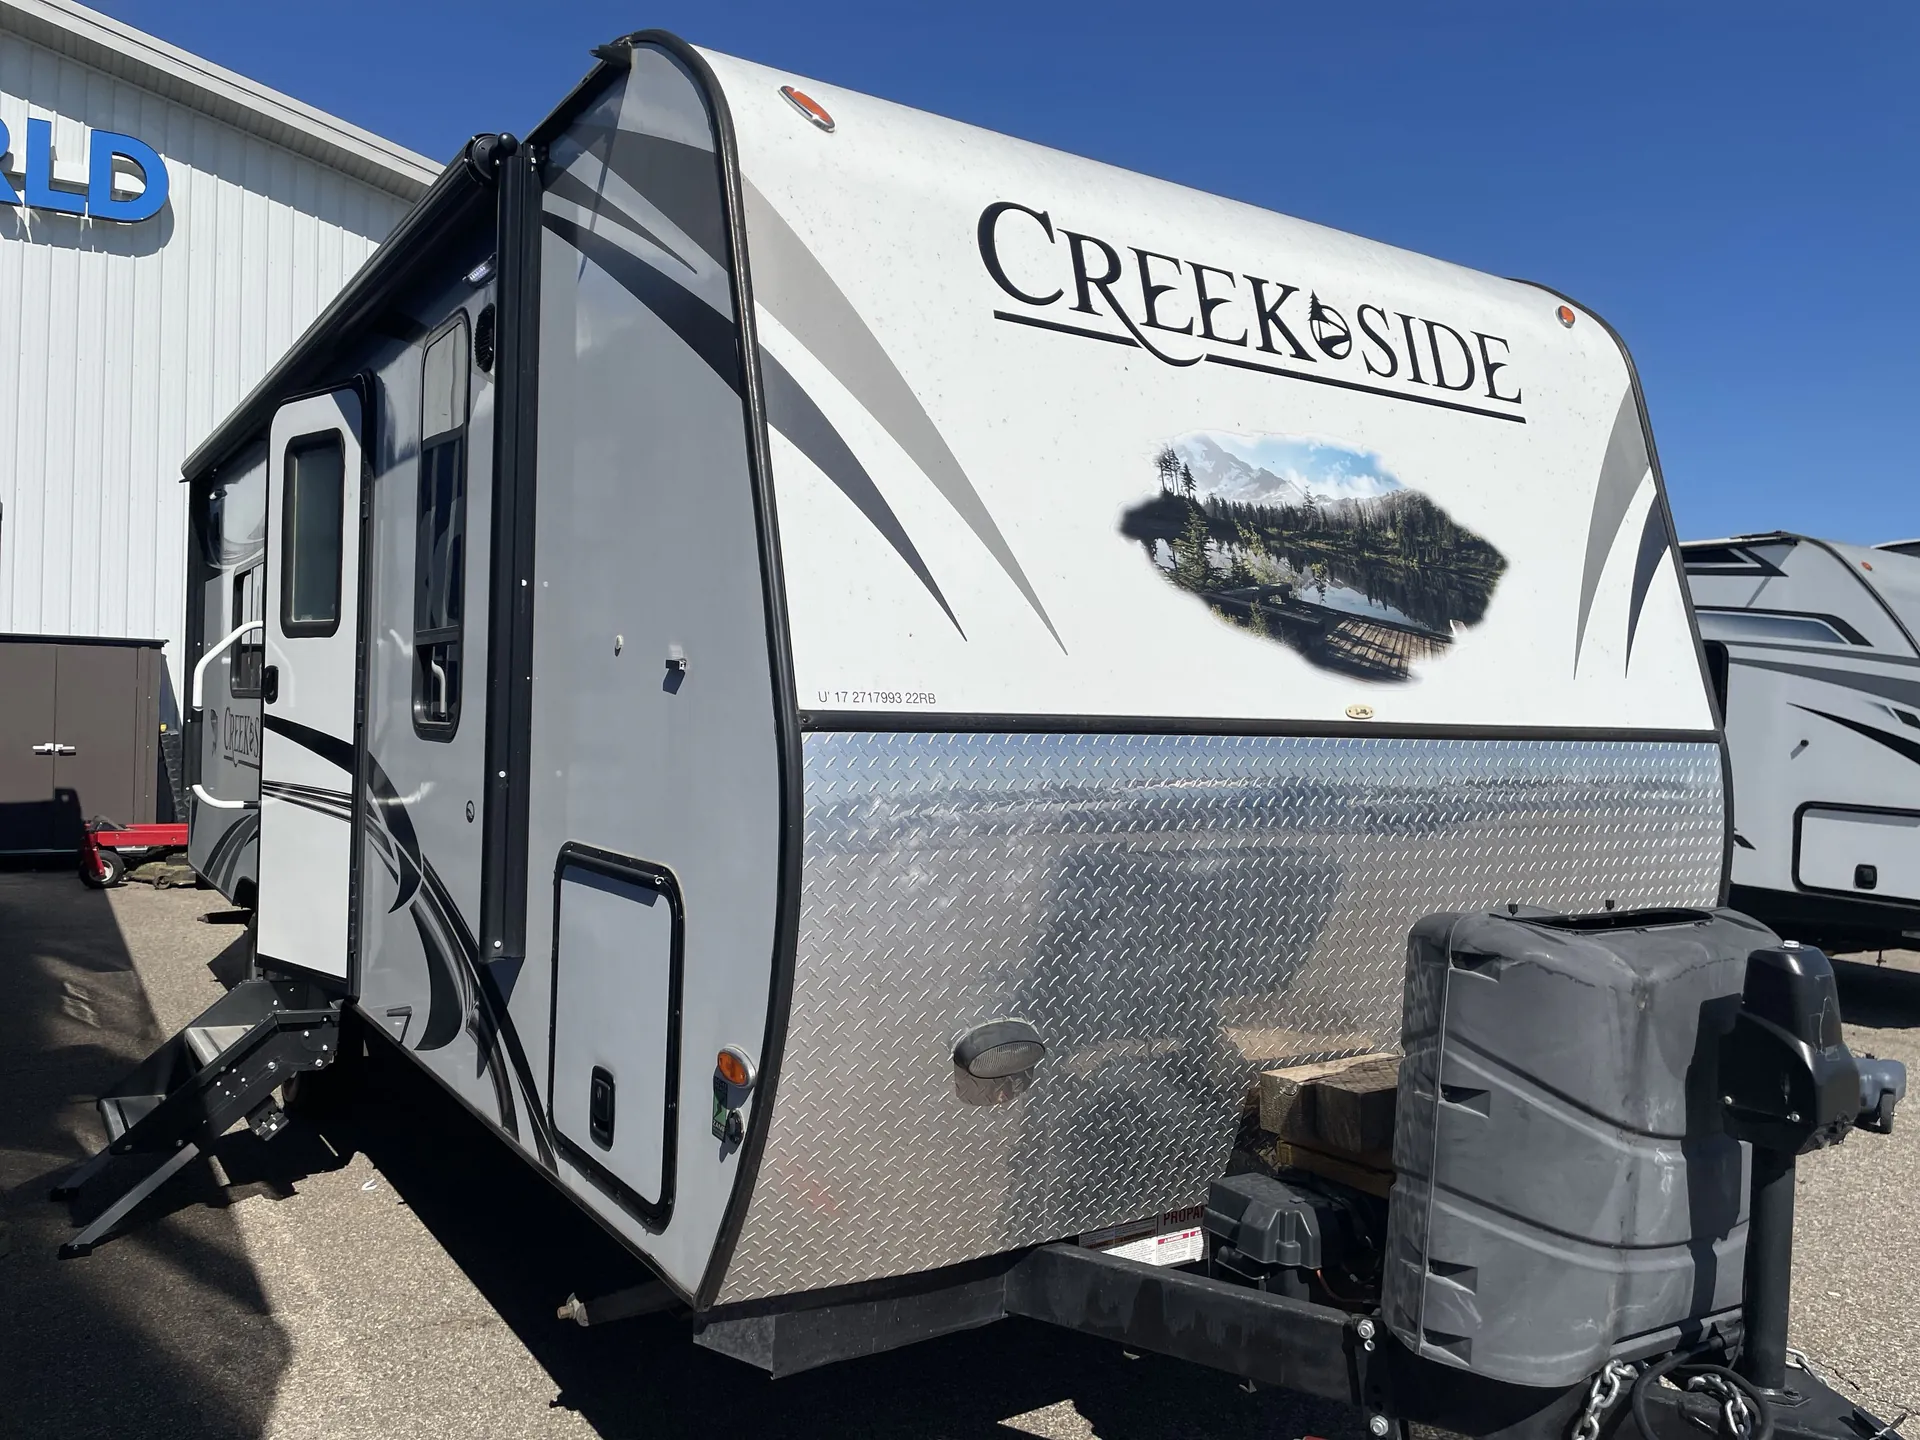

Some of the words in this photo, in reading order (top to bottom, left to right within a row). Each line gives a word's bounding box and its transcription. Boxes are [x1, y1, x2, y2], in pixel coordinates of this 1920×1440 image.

[835, 691, 848, 703] 17
[852, 691, 902, 704] 2717993
[905, 692, 937, 704] 22RB
[224, 707, 260, 768] CREEKS
[1163, 1204, 1205, 1226] PROPA
